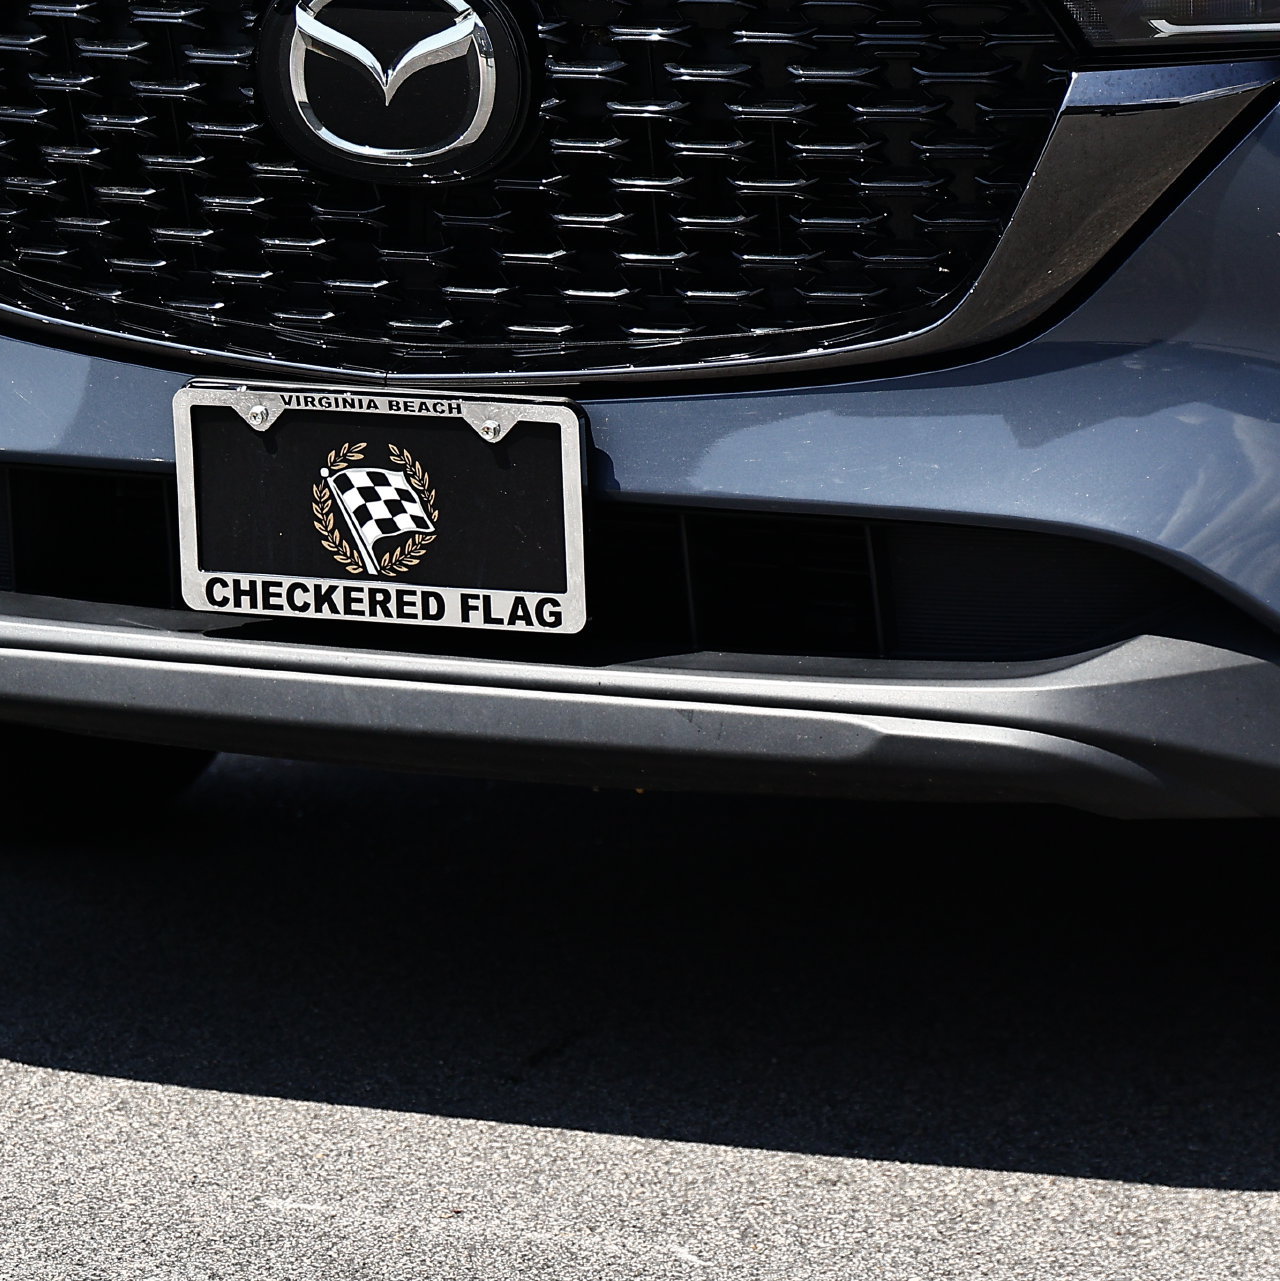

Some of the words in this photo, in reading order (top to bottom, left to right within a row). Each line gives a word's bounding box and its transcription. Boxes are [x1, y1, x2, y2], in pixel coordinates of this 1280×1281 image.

[280, 394, 379, 410] VIRGINIA
[388, 399, 462, 415] BEACH
[205, 576, 446, 621] CHECKERED
[461, 593, 563, 629] FLAG
